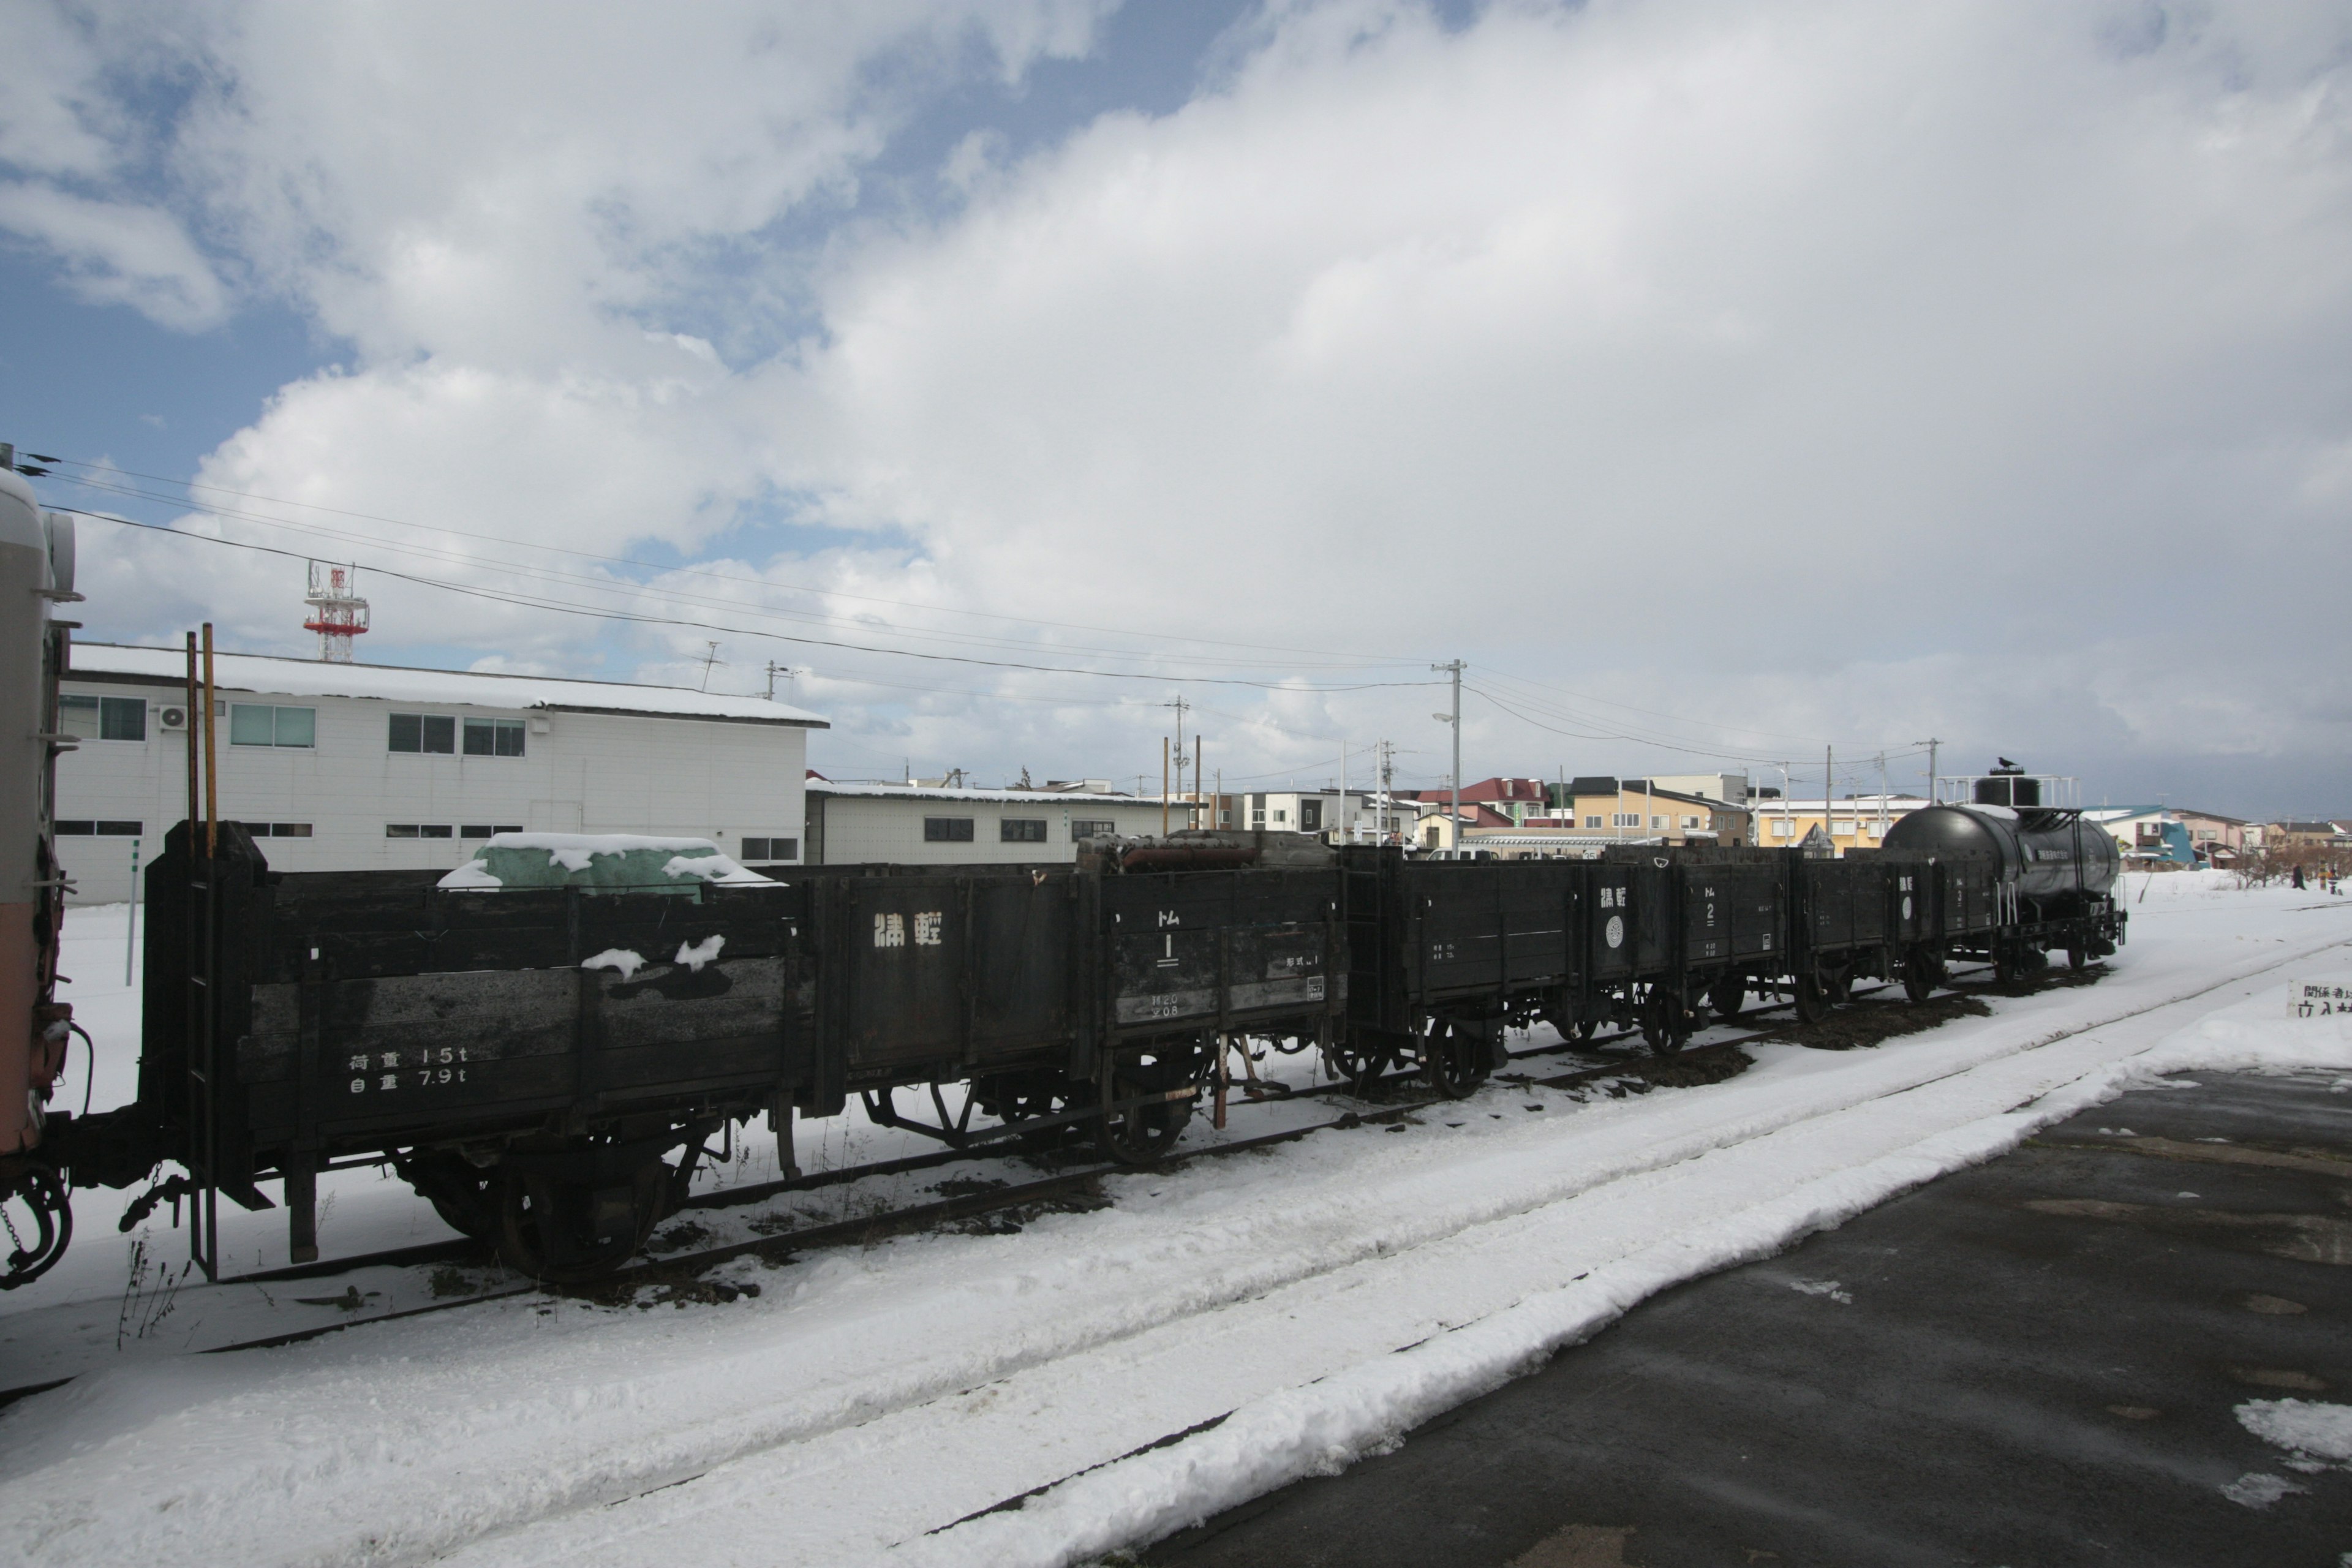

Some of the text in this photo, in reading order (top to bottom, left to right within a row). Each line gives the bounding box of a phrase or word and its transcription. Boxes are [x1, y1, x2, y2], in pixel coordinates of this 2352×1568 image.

[1158, 910, 1180, 927] トム
[1707, 903, 1714, 919] 2
[1163, 1006, 1178, 1017] 0.8
[349, 1051, 401, 1070] 荷重
[350, 1068, 466, 1093] 自重 7.9t
